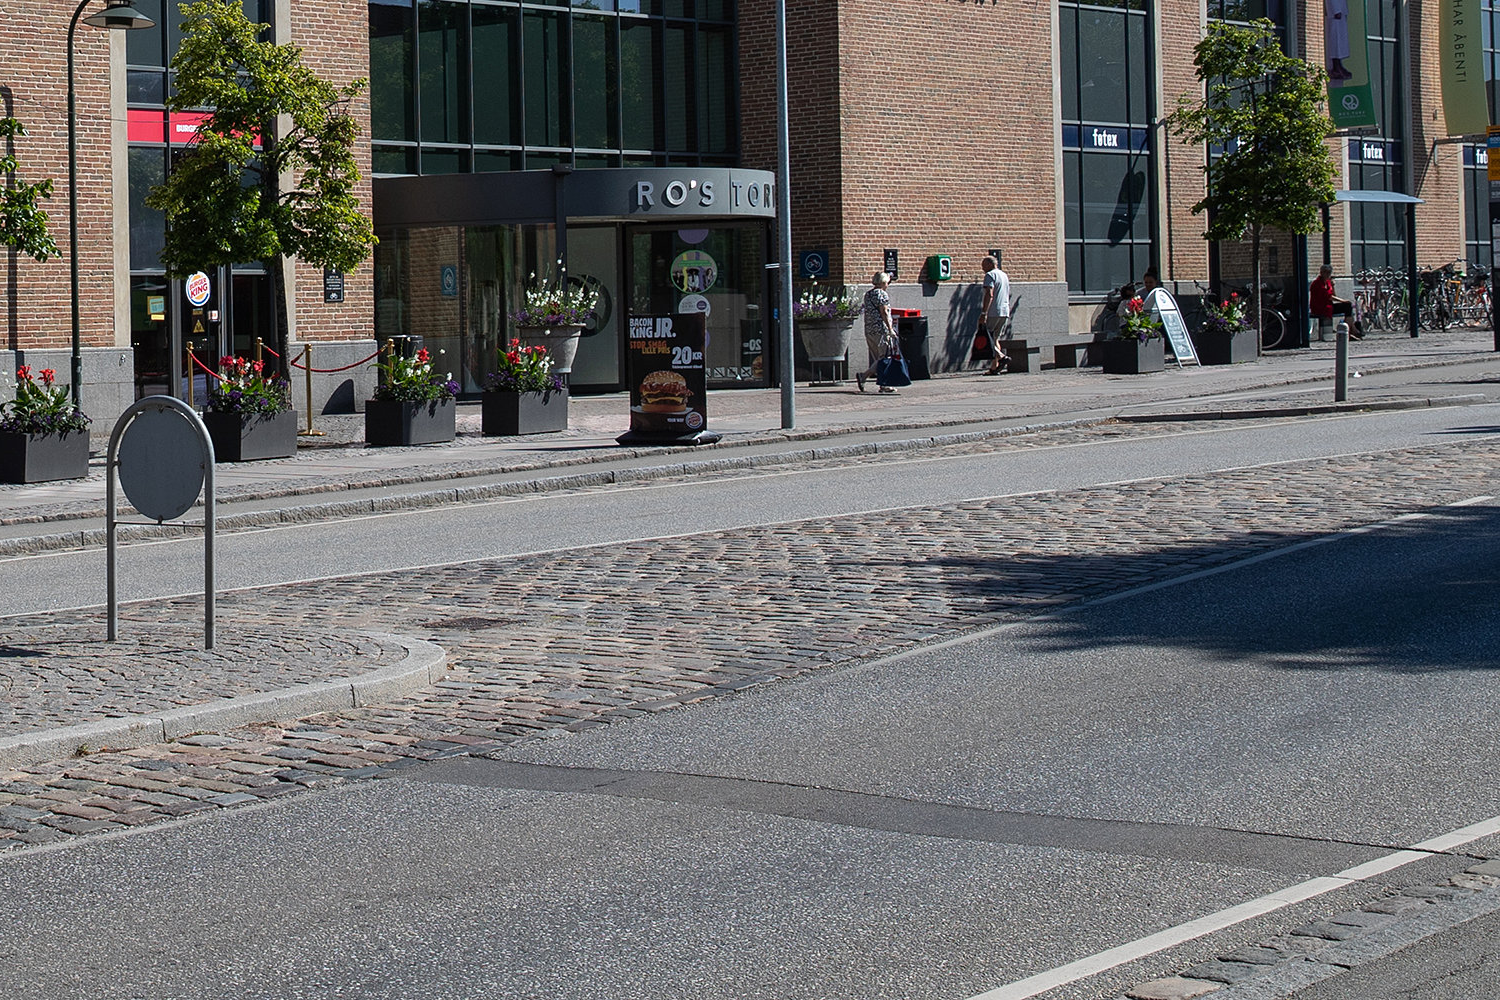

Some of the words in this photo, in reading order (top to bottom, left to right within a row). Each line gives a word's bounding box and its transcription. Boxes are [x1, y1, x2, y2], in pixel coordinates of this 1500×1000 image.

[1453, 0, 1464, 27] HAR
[637, 180, 715, 205] RO'S
[731, 180, 776, 208] TOR
[189, 277, 207, 291] BURGER
[190, 282, 208, 299] KING
[629, 317, 653, 327] BACON
[654, 317, 676, 338] JR.
[672, 346, 692, 364] 20
[692, 351, 703, 360] KR
